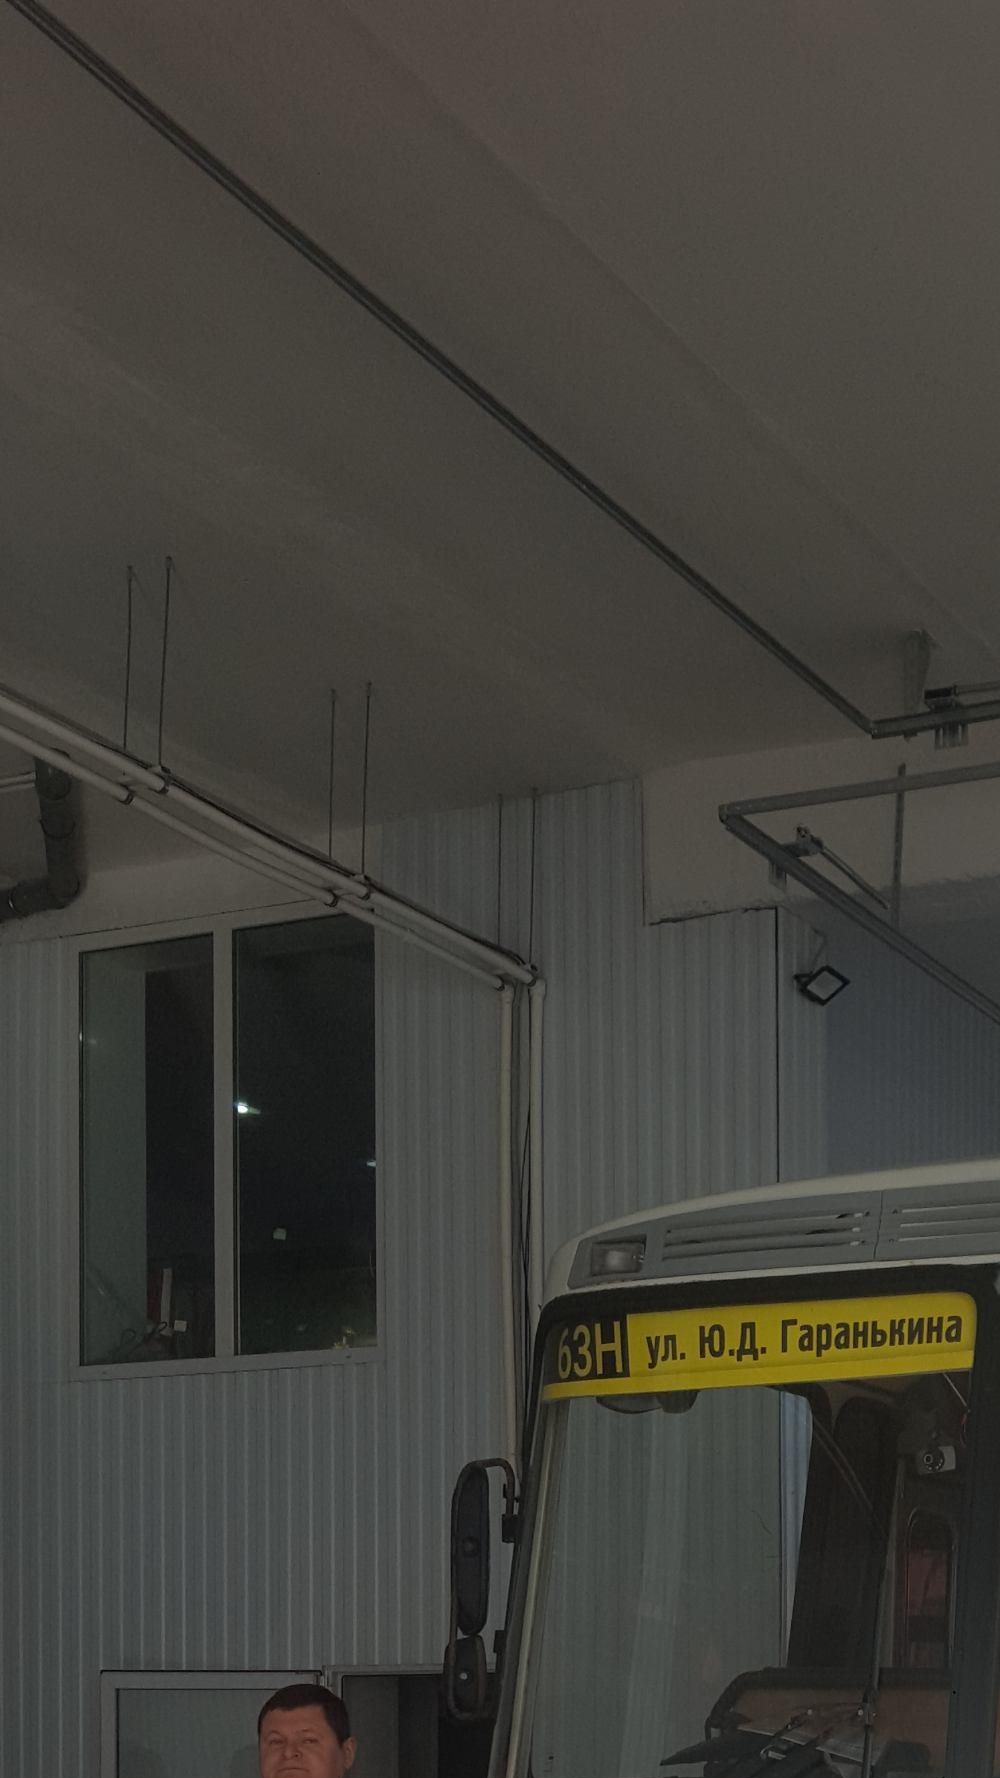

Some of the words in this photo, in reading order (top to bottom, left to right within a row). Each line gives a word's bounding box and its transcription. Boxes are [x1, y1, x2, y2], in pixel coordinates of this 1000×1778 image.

[646, 1333, 686, 1369] ул.
[700, 1322, 767, 1362] Ю.Д.
[780, 1314, 963, 1358] Гаранькина
